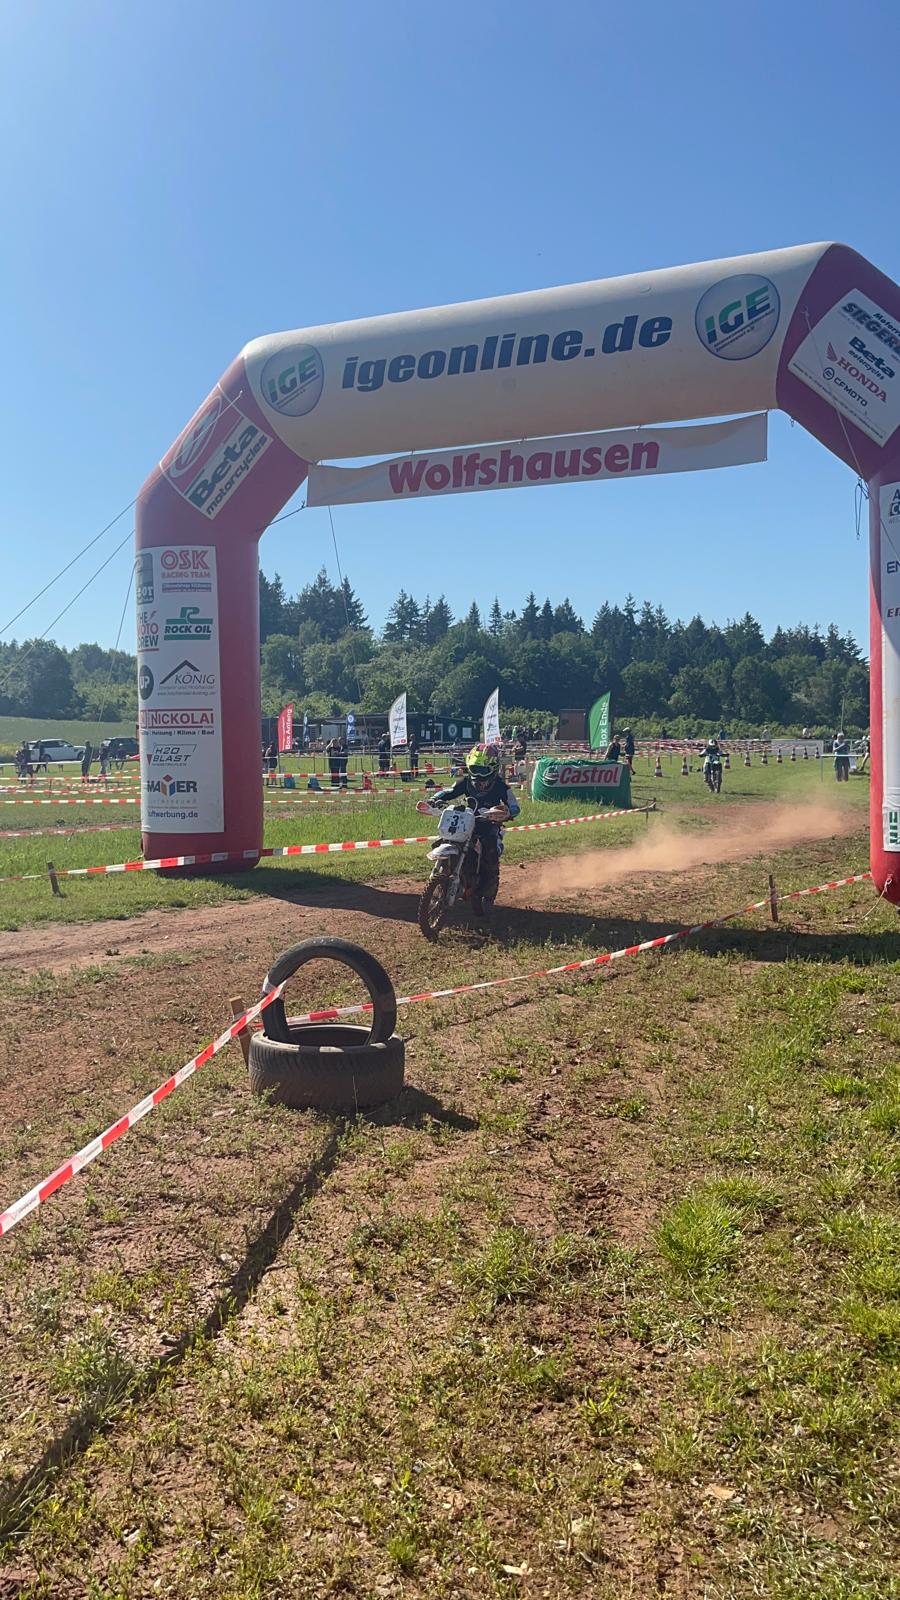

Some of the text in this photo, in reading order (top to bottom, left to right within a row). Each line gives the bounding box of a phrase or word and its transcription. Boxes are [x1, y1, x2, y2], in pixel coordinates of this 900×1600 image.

[705, 285, 771, 345] IGE
[342, 315, 673, 392] igeonline.de
[849, 336, 896, 379] Beta
[268, 354, 317, 403] IGE
[836, 357, 887, 403] HONDA
[834, 377, 868, 407] CFMOTO
[188, 425, 259, 508] Beta
[207, 435, 268, 515] motorcycles
[389, 441, 660, 494] Wolfshausen
[161, 550, 210, 570] OSK
[164, 625, 212, 634] ROCK OIL
[174, 671, 216, 684] KÖNIG
[151, 711, 214, 727] NICKOLAI
[600, 728, 608, 747] Box
[153, 754, 192, 762] BLAST
[155, 747, 180, 755] H2O
[559, 767, 619, 784] Castrol
[451, 814, 459, 827] 3
